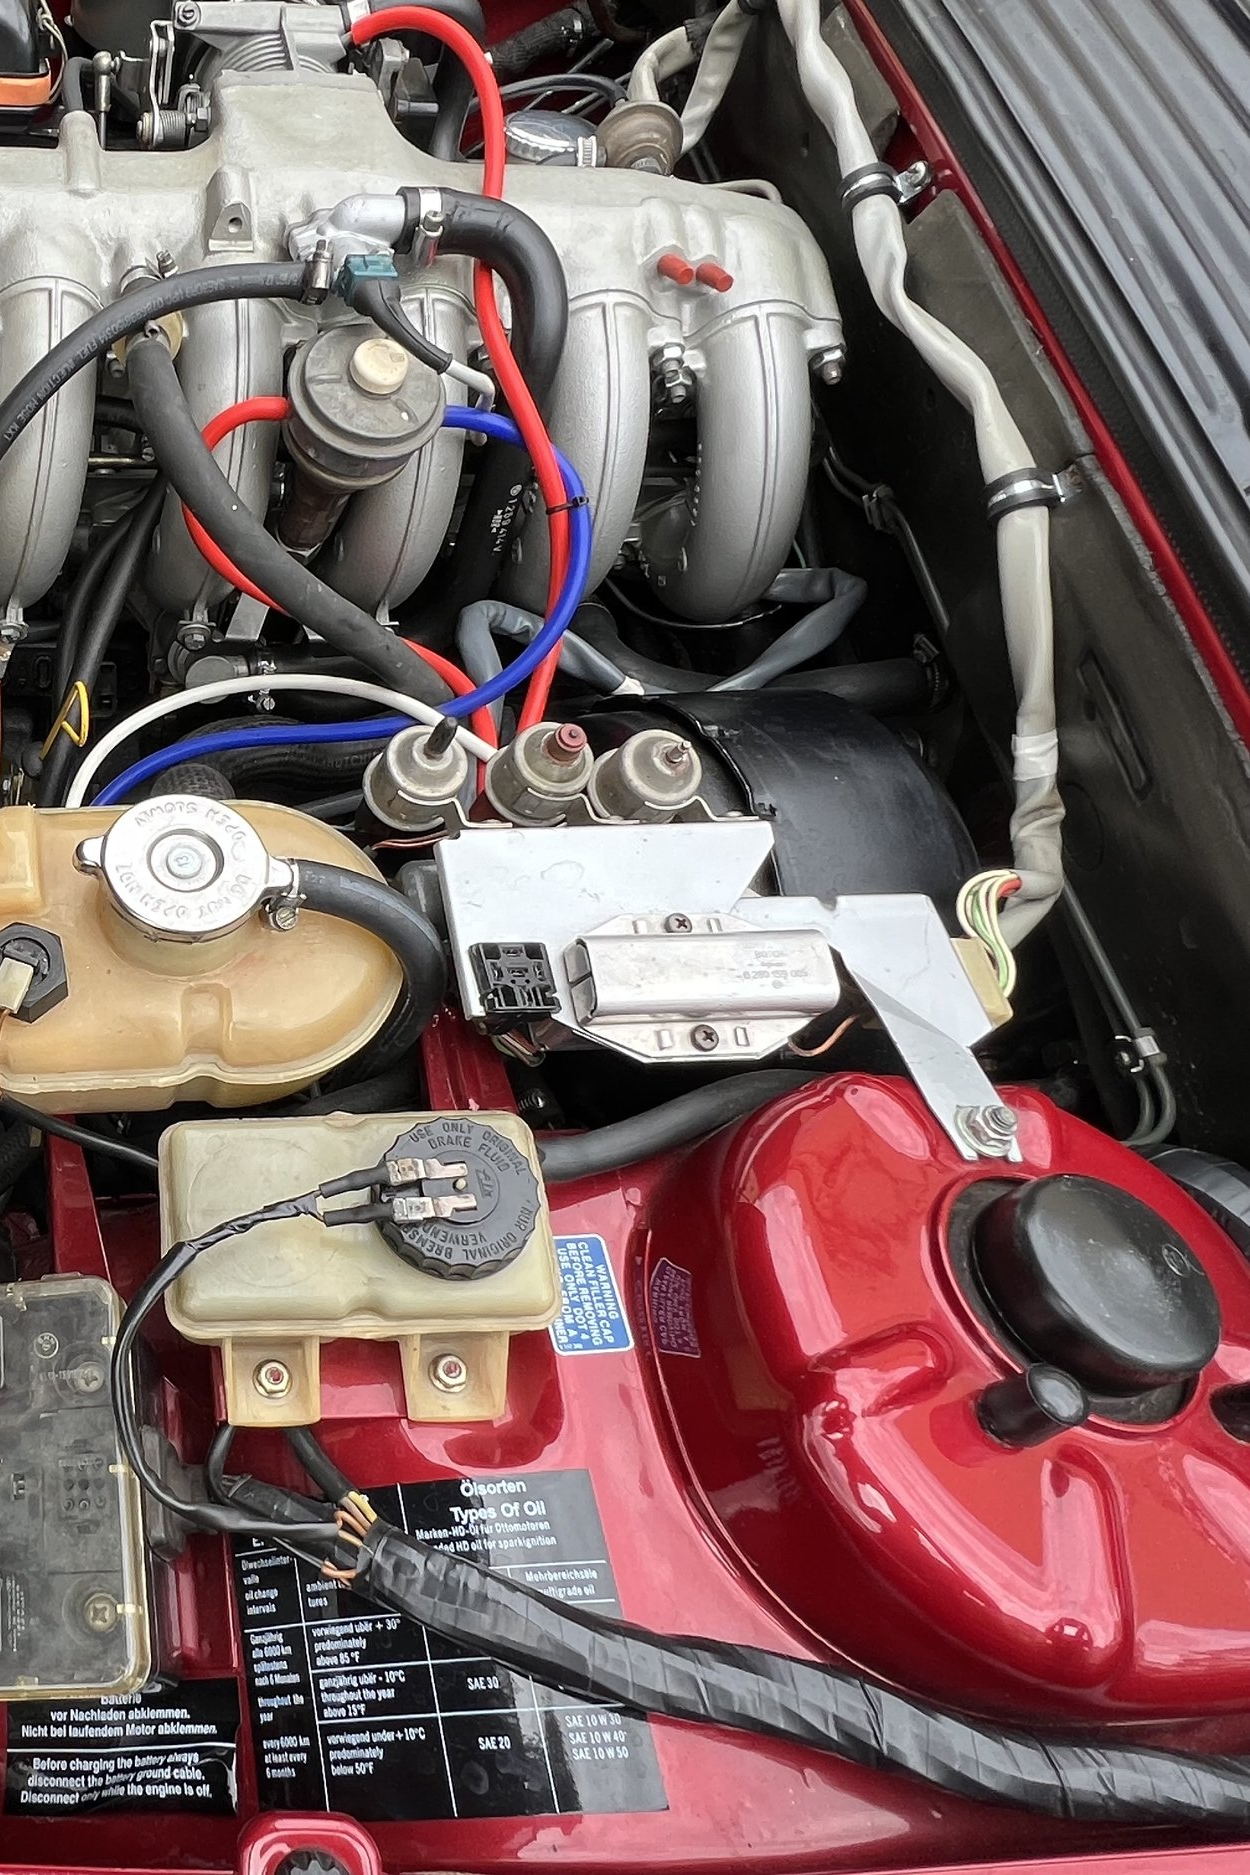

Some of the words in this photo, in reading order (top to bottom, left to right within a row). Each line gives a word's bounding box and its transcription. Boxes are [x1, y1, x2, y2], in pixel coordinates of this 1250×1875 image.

[409, 1125, 433, 1143] USE
[442, 1122, 474, 1134] ONLY
[482, 1130, 527, 1176] ORIGINAL
[428, 1136, 473, 1150] BRAKE
[477, 1143, 510, 1172] FLUID
[464, 1232, 518, 1261] ORIGINAL
[558, 1248, 570, 1269] USE
[565, 1274, 580, 1303] ONLY
[566, 1242, 586, 1285] BEFORE
[579, 1283, 603, 1346] REMOVING
[578, 1241, 596, 1278] CLEAN
[589, 1280, 607, 1318] FILLER
[600, 1318, 615, 1343] CAP
[595, 1264, 619, 1319] WARNING
[574, 1308, 588, 1331] DOT
[567, 1328, 579, 1338] A
[580, 1331, 590, 1341] 4
[460, 1479, 527, 1497] Ölsorten
[450, 1506, 497, 1525] Types
[501, 1501, 520, 1517] Of
[523, 1500, 546, 1517] Oil
[495, 1519, 551, 1534] Ottomotoren
[456, 1540, 470, 1552] HD
[471, 1538, 482, 1551] oil
[483, 1538, 496, 1550] for
[498, 1534, 557, 1551] sparkignition
[306, 1579, 338, 1593] ambient
[583, 1584, 596, 1596] oil
[245, 1591, 254, 1602] oil
[254, 1588, 279, 1601] change
[307, 1597, 328, 1608] tures
[247, 1602, 276, 1616] intervals
[312, 1623, 353, 1637] vorwiegend
[386, 1618, 401, 1630] 30°
[264, 1645, 281, 1657] 6000
[281, 1644, 293, 1655] km
[316, 1655, 339, 1666] above
[467, 1677, 487, 1691] SAE
[487, 1676, 500, 1689] 30
[258, 1695, 291, 1709] throughout
[293, 1694, 305, 1705] the
[321, 1690, 362, 1704] throughout
[363, 1688, 376, 1700] the
[377, 1687, 395, 1701] year
[50, 1711, 68, 1721] vor
[70, 1708, 126, 1721] Nachladen
[128, 1707, 190, 1719] abklemmen.
[260, 1712, 274, 1724] year
[323, 1706, 347, 1718] above
[565, 1714, 585, 1728] SAE
[586, 1714, 598, 1727] 10
[599, 1714, 608, 1726] W
[608, 1713, 622, 1725] 30
[21, 1725, 48, 1737] Nicht
[50, 1724, 66, 1737] bei
[68, 1724, 124, 1737] laufendem
[126, 1723, 156, 1736] Motor
[158, 1722, 217, 1735] abklemmen.
[263, 1738, 280, 1750] every
[280, 1736, 298, 1748] 6000
[299, 1735, 310, 1746] km
[327, 1730, 370, 1746] vorwiegend
[371, 1729, 395, 1742] under
[478, 1736, 498, 1750] SAE
[499, 1735, 511, 1750] 20
[569, 1732, 589, 1745] SAE
[590, 1731, 601, 1744] 10
[601, 1731, 613, 1743] W
[264, 1753, 273, 1764] at
[273, 1752, 289, 1763] least
[288, 1751, 307, 1767] every
[572, 1747, 593, 1760] SAE
[593, 1747, 605, 1759] 10
[605, 1747, 616, 1759] W
[617, 1746, 629, 1759] 50
[33, 1757, 67, 1771] Before
[69, 1757, 115, 1774] charging
[117, 1756, 133, 1769] the
[134, 1755, 166, 1768] battery
[167, 1752, 199, 1766] always
[331, 1763, 353, 1776] below
[27, 1774, 85, 1787] disconnect
[88, 1774, 104, 1788] the
[136, 1765, 172, 1782] ground
[172, 1766, 205, 1780] cable.
[271, 1766, 296, 1779] months
[20, 1790, 80, 1804] Disconnect
[101, 1785, 126, 1797] while
[127, 1783, 143, 1796] the
[145, 1782, 182, 1798] engine
[184, 1782, 194, 1796] is
[196, 1784, 212, 1798] off.
